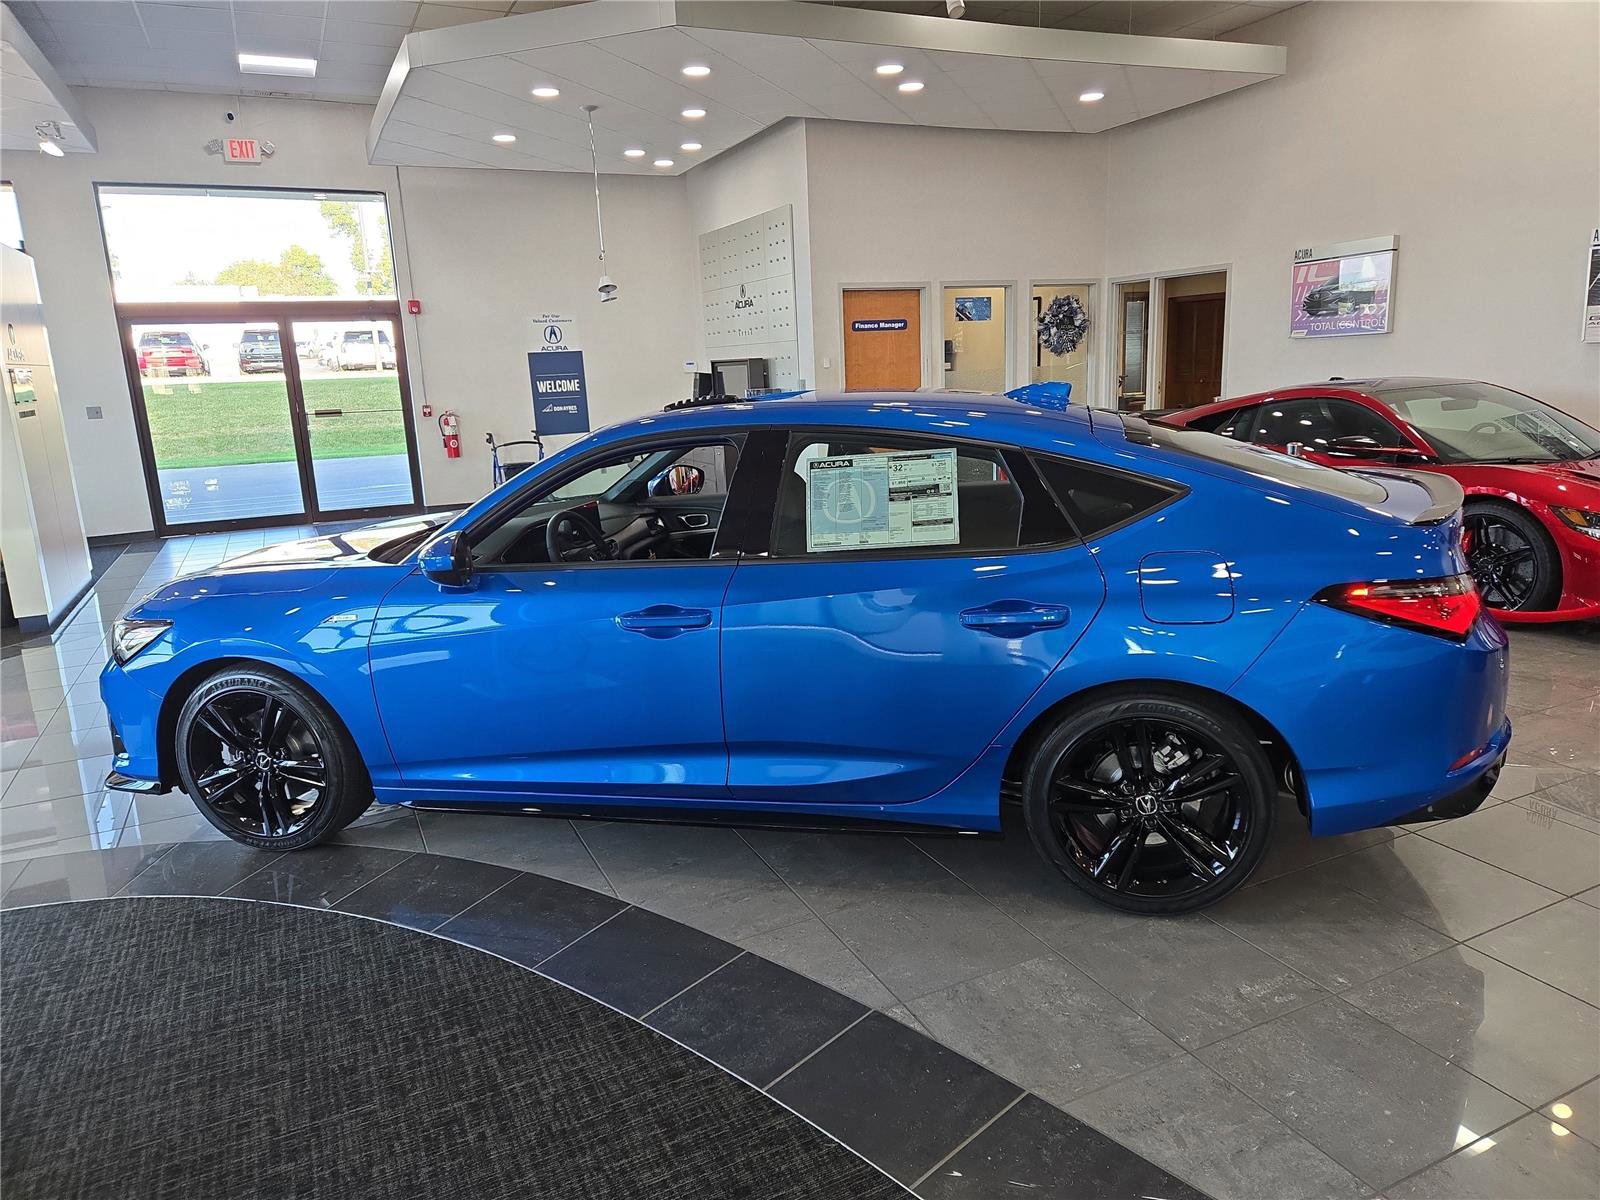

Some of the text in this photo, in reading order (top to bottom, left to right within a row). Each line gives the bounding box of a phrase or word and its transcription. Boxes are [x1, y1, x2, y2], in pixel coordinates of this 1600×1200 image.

[229, 140, 255, 158] EXIT
[1294, 248, 1313, 260] ACURA
[735, 299, 753, 310] ACURA
[536, 379, 580, 393] WELCOME
[819, 460, 850, 468] ACURA
[892, 464, 903, 472] 32
[211, 678, 272, 694] ASSURANCE
